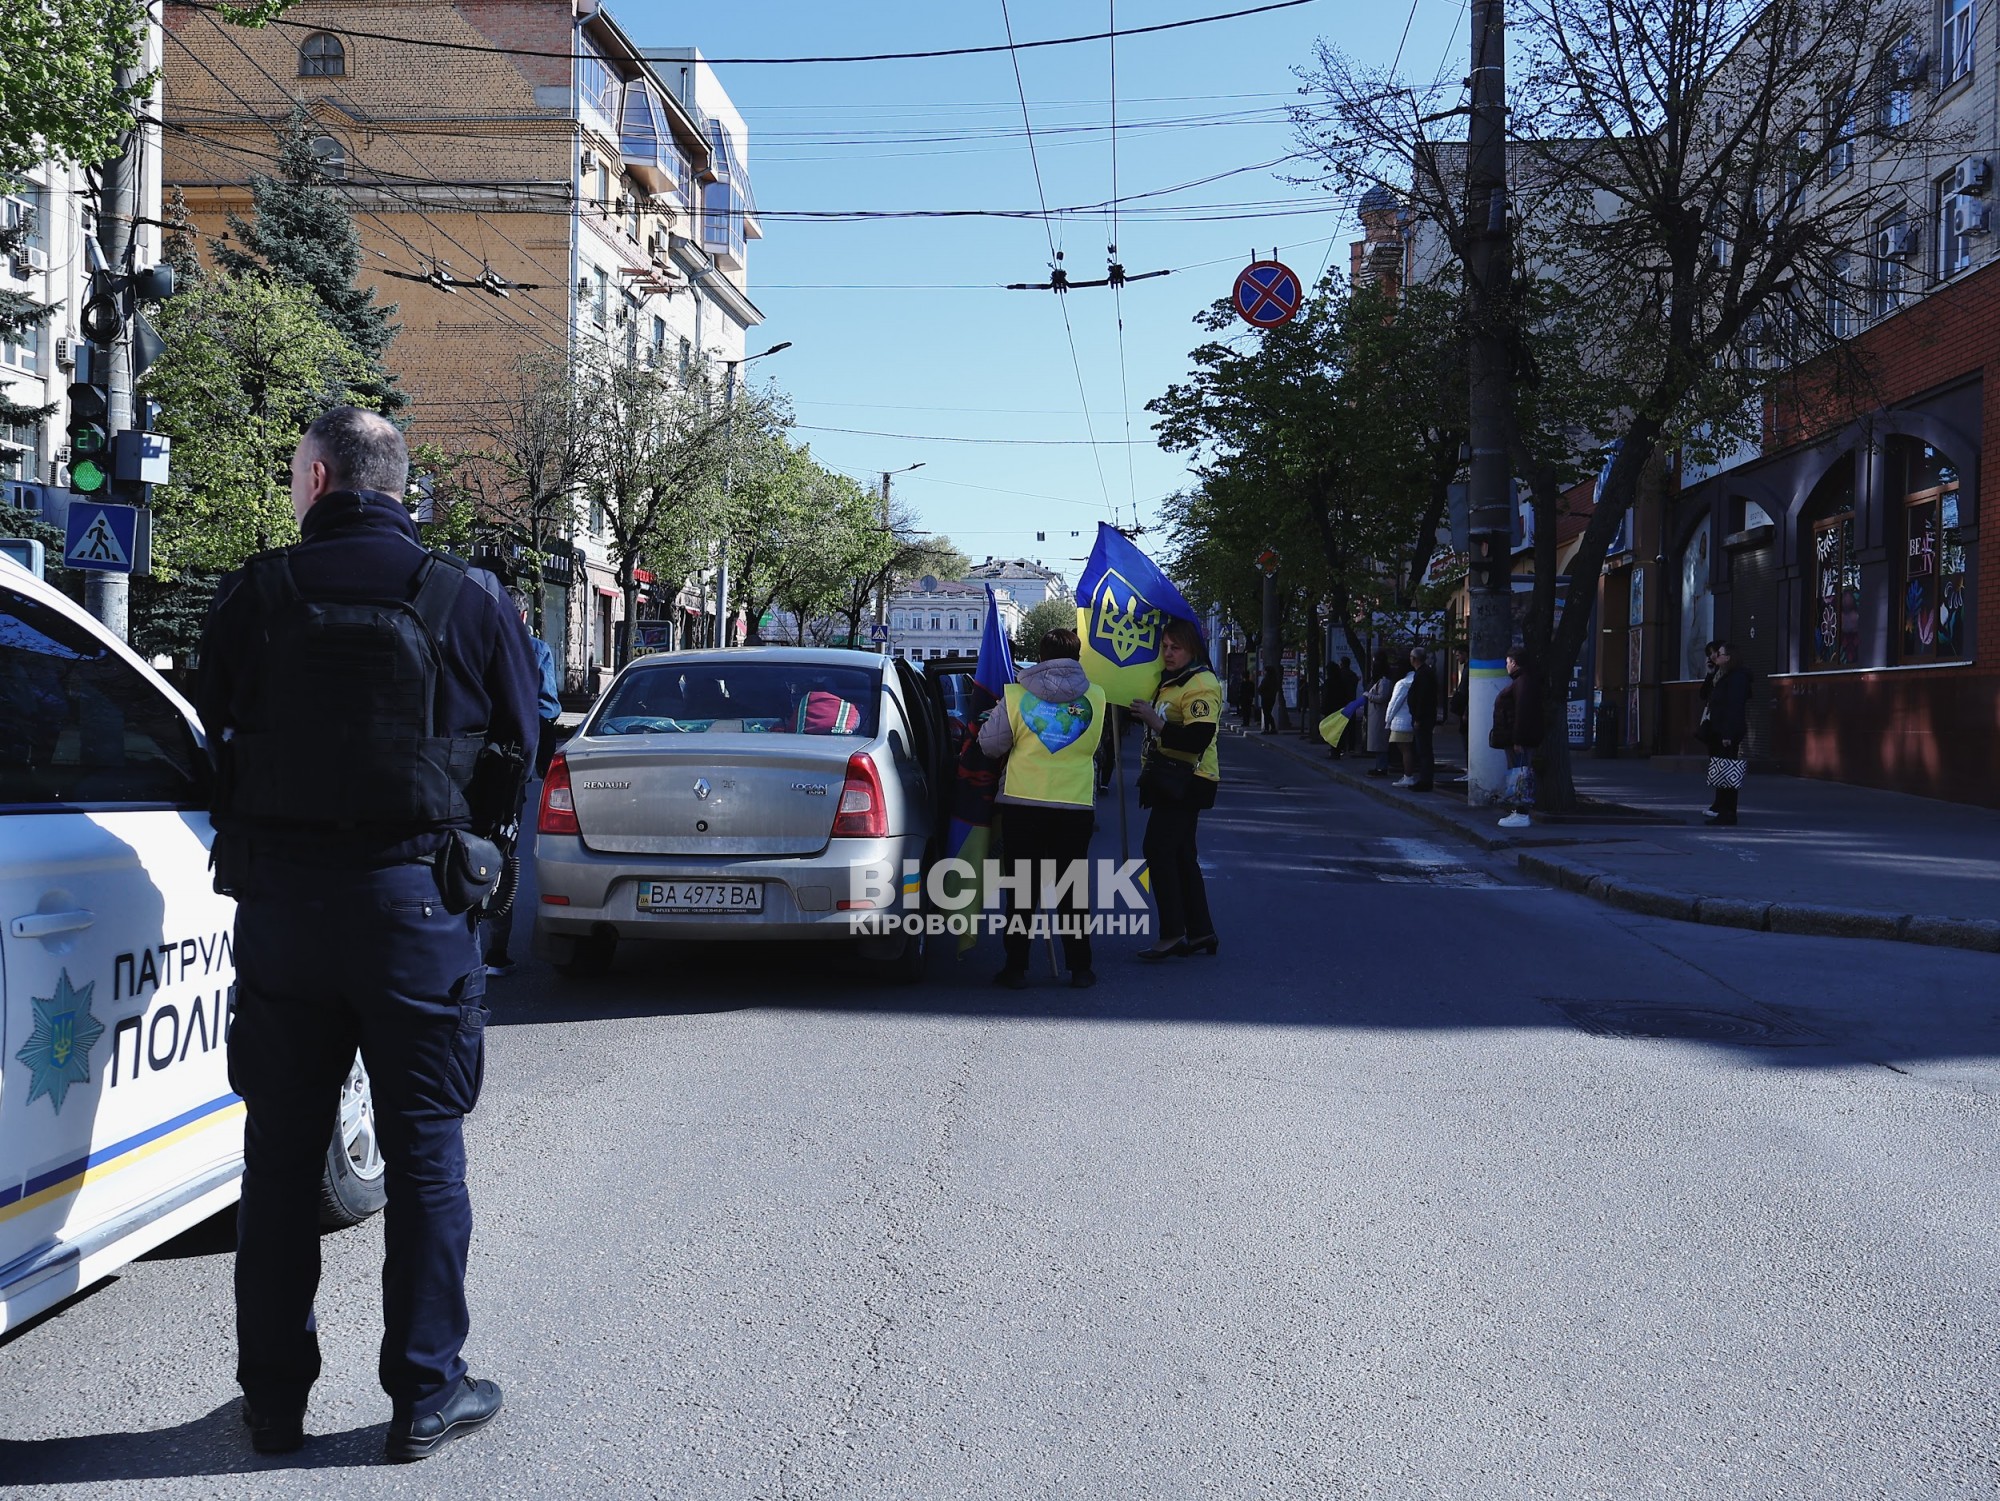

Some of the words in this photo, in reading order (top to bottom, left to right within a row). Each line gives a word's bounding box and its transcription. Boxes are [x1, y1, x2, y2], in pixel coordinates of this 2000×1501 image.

[583, 781, 631, 789] RENAULT
[683, 886, 726, 904] 4973
[114, 930, 235, 1001] ПАТРУЛ
